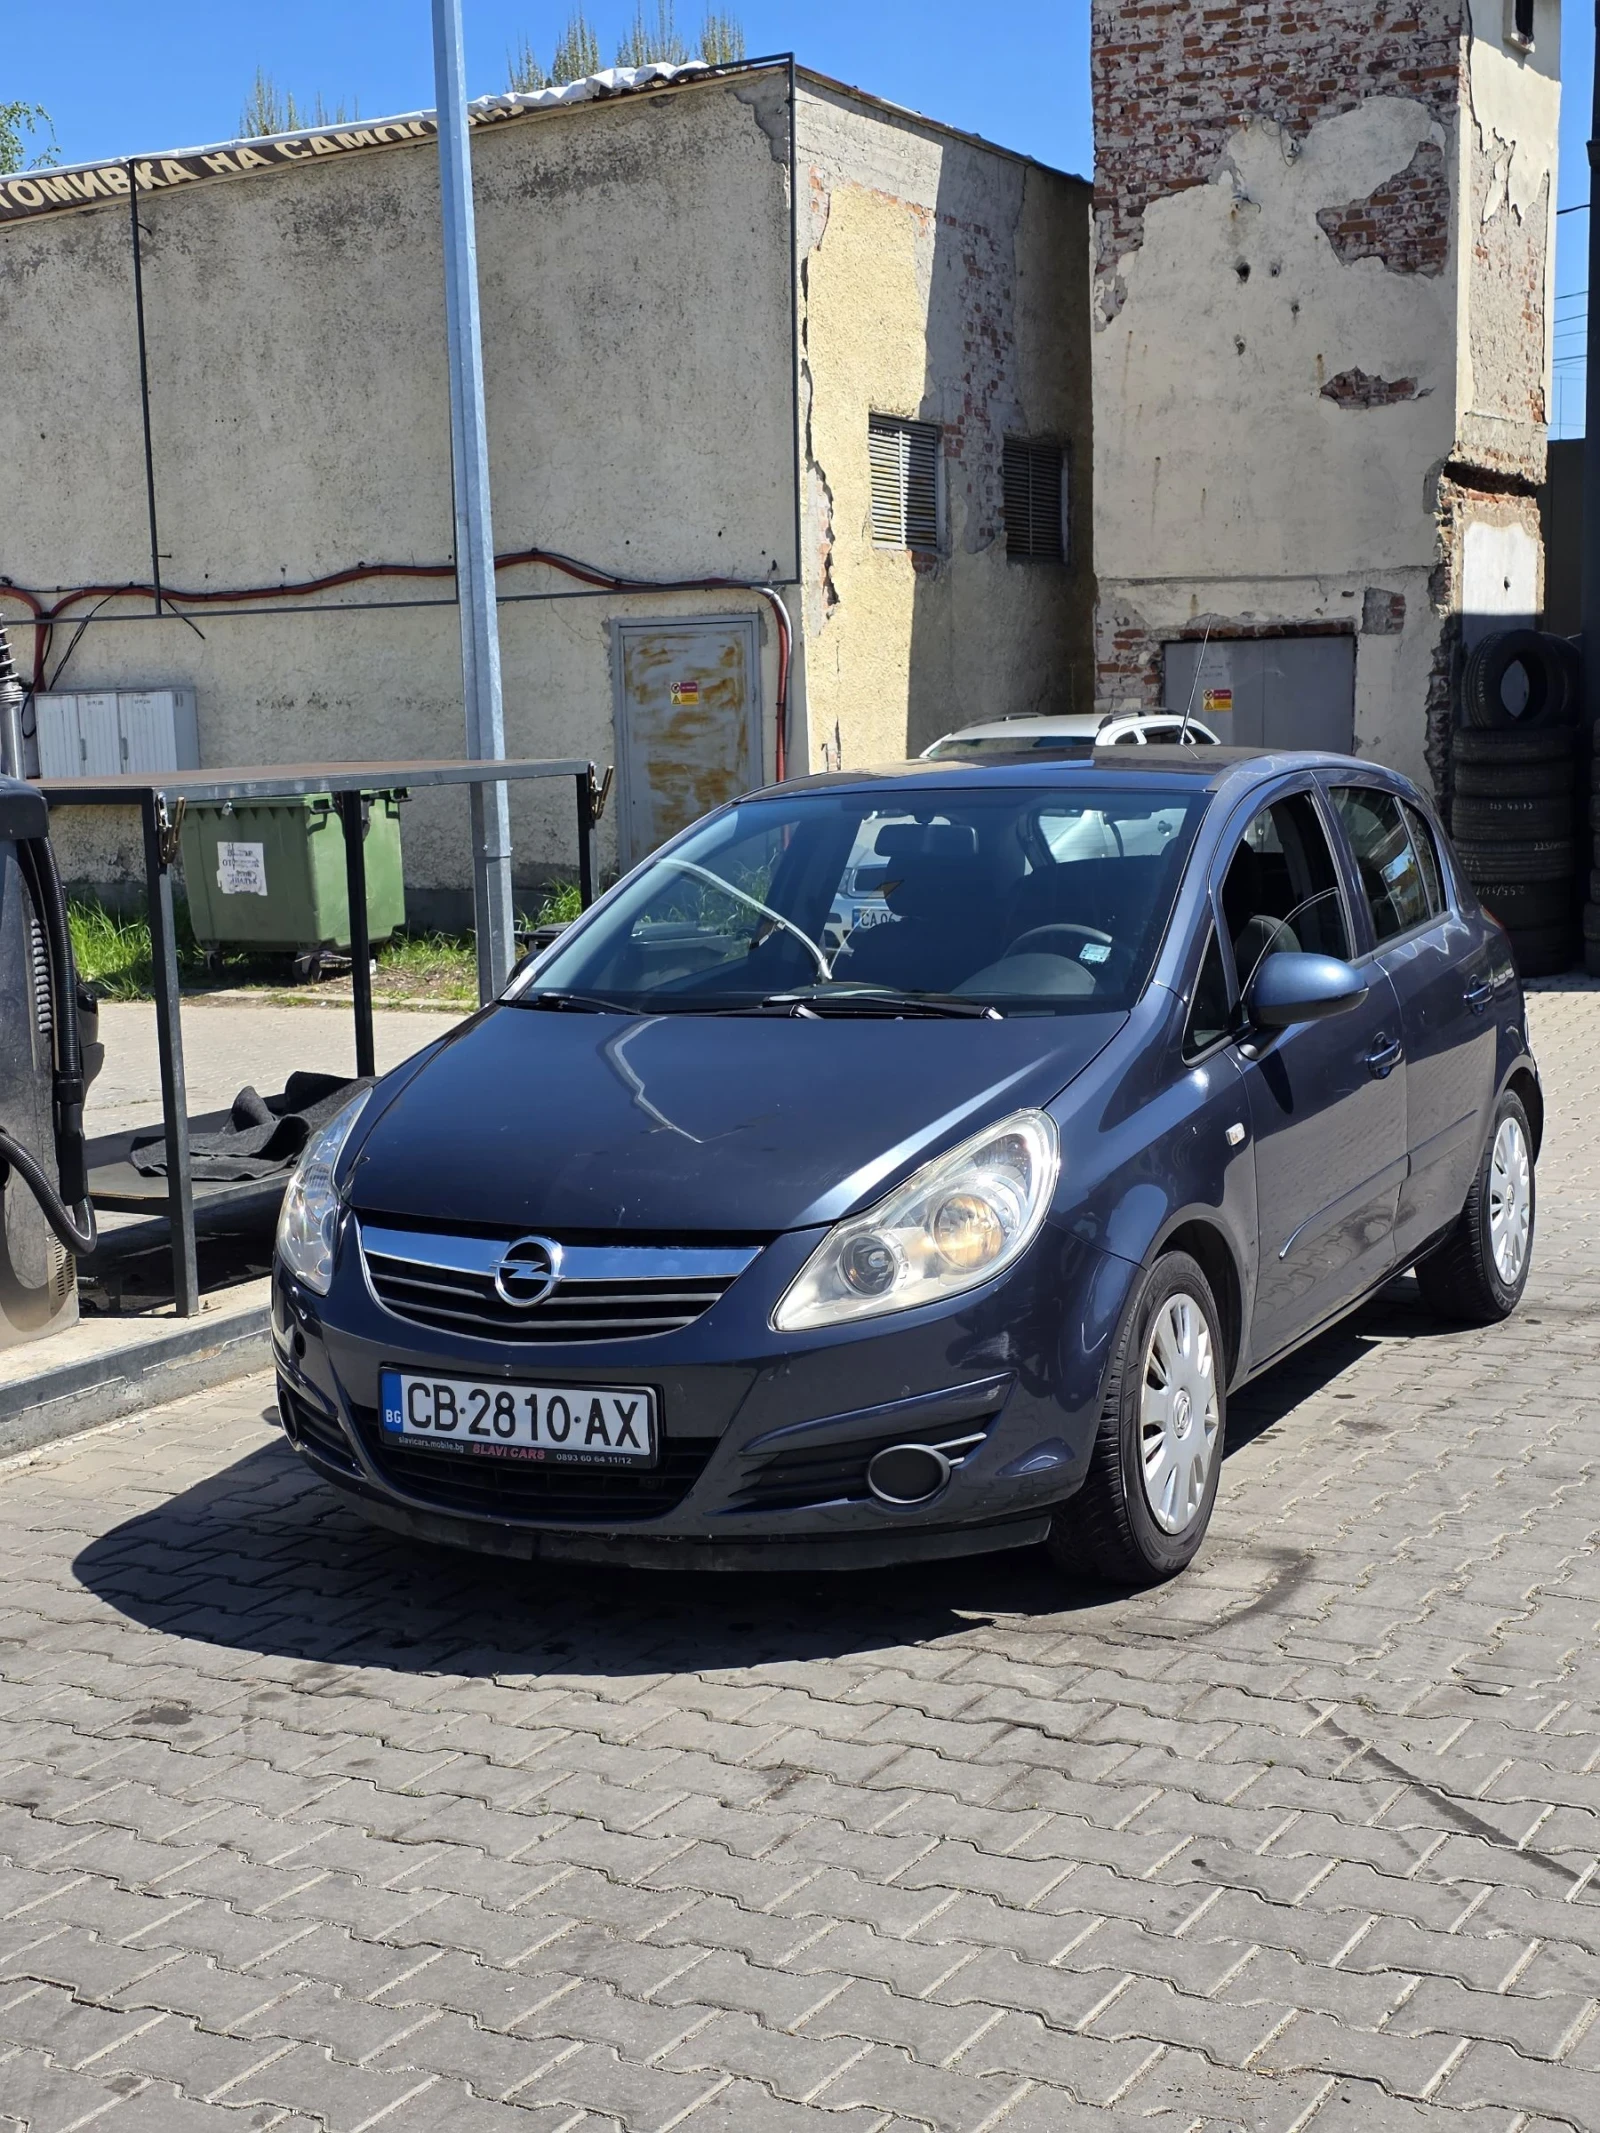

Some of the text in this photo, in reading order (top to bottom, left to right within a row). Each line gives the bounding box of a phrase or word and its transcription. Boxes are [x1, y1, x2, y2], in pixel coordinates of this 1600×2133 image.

[201, 148, 274, 174] НА
[385, 1409, 402, 1424] BG
[407, 1382, 641, 1449] CB 2810 AX
[398, 1435, 632, 1465] slavicars.mobile.bg SLAVI CARS 0893 60 64 11/12
